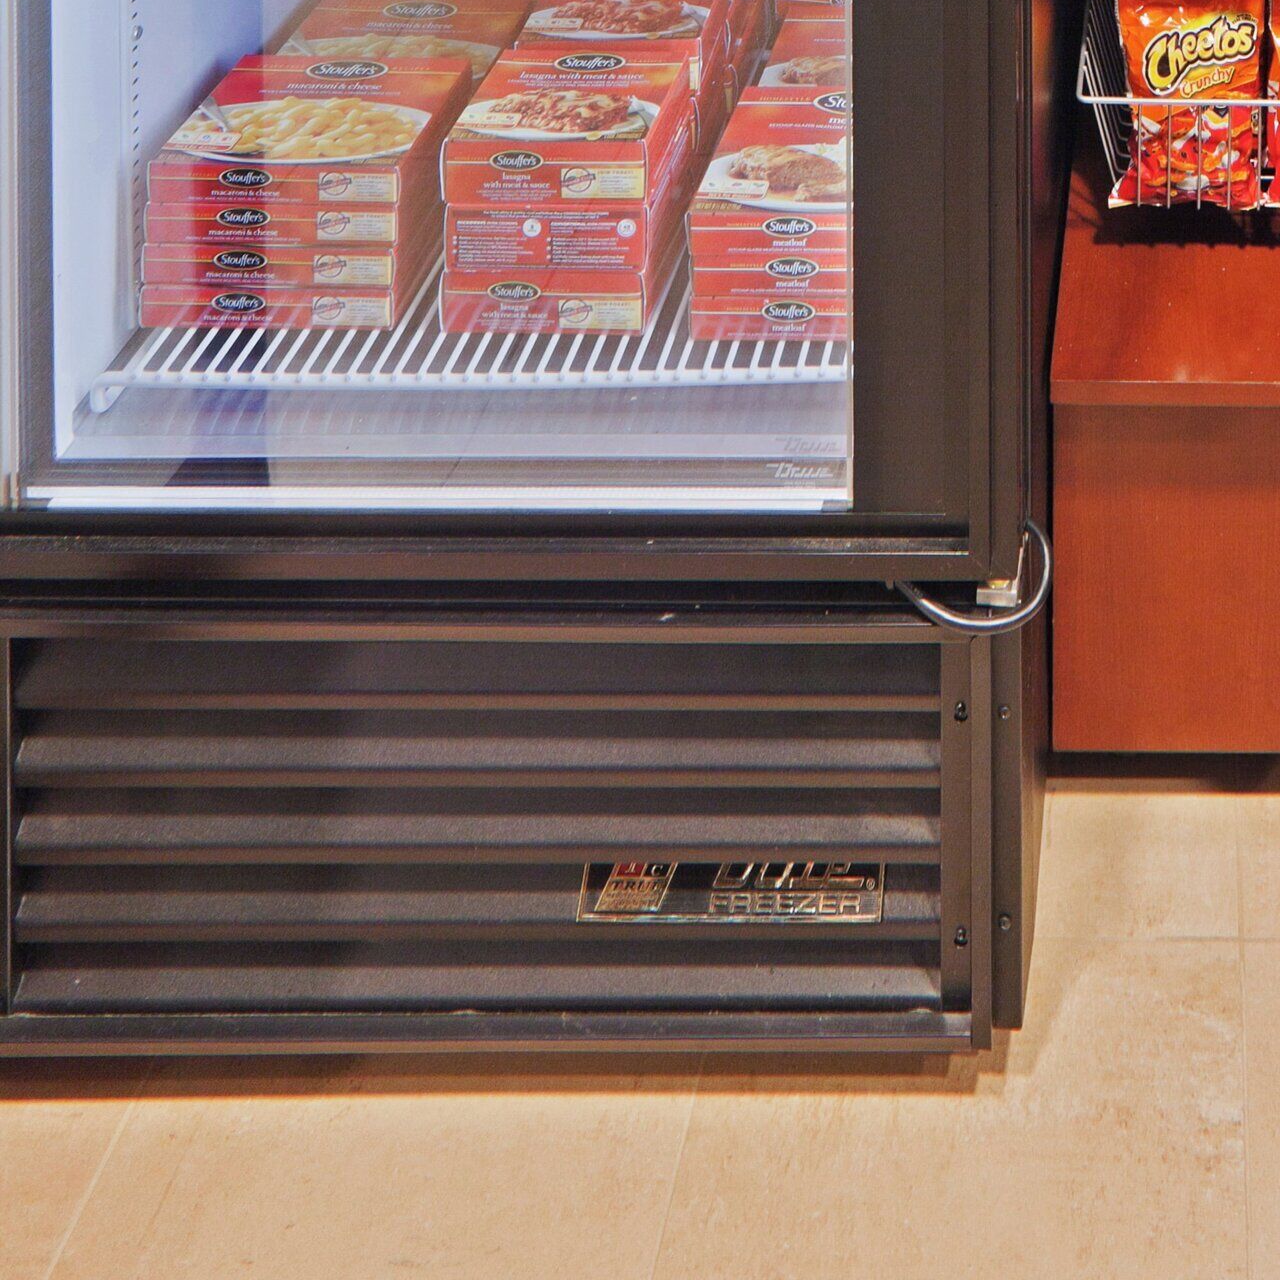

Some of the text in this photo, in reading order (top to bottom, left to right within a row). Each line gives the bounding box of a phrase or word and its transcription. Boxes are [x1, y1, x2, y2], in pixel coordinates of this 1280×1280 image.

[1144, 17, 1255, 94] Cheetos
[314, 62, 379, 79] Stouffer's
[287, 82, 338, 91] macaroni
[349, 82, 382, 91] cheese
[1180, 67, 1235, 98] Crunchy
[496, 153, 538, 169] Stouffer's
[225, 171, 267, 185] Stouffer's
[211, 189, 247, 197] macaroni
[255, 189, 280, 197] cheese
[768, 219, 810, 234] Stouffer's
[708, 891, 861, 914] FREEZER
